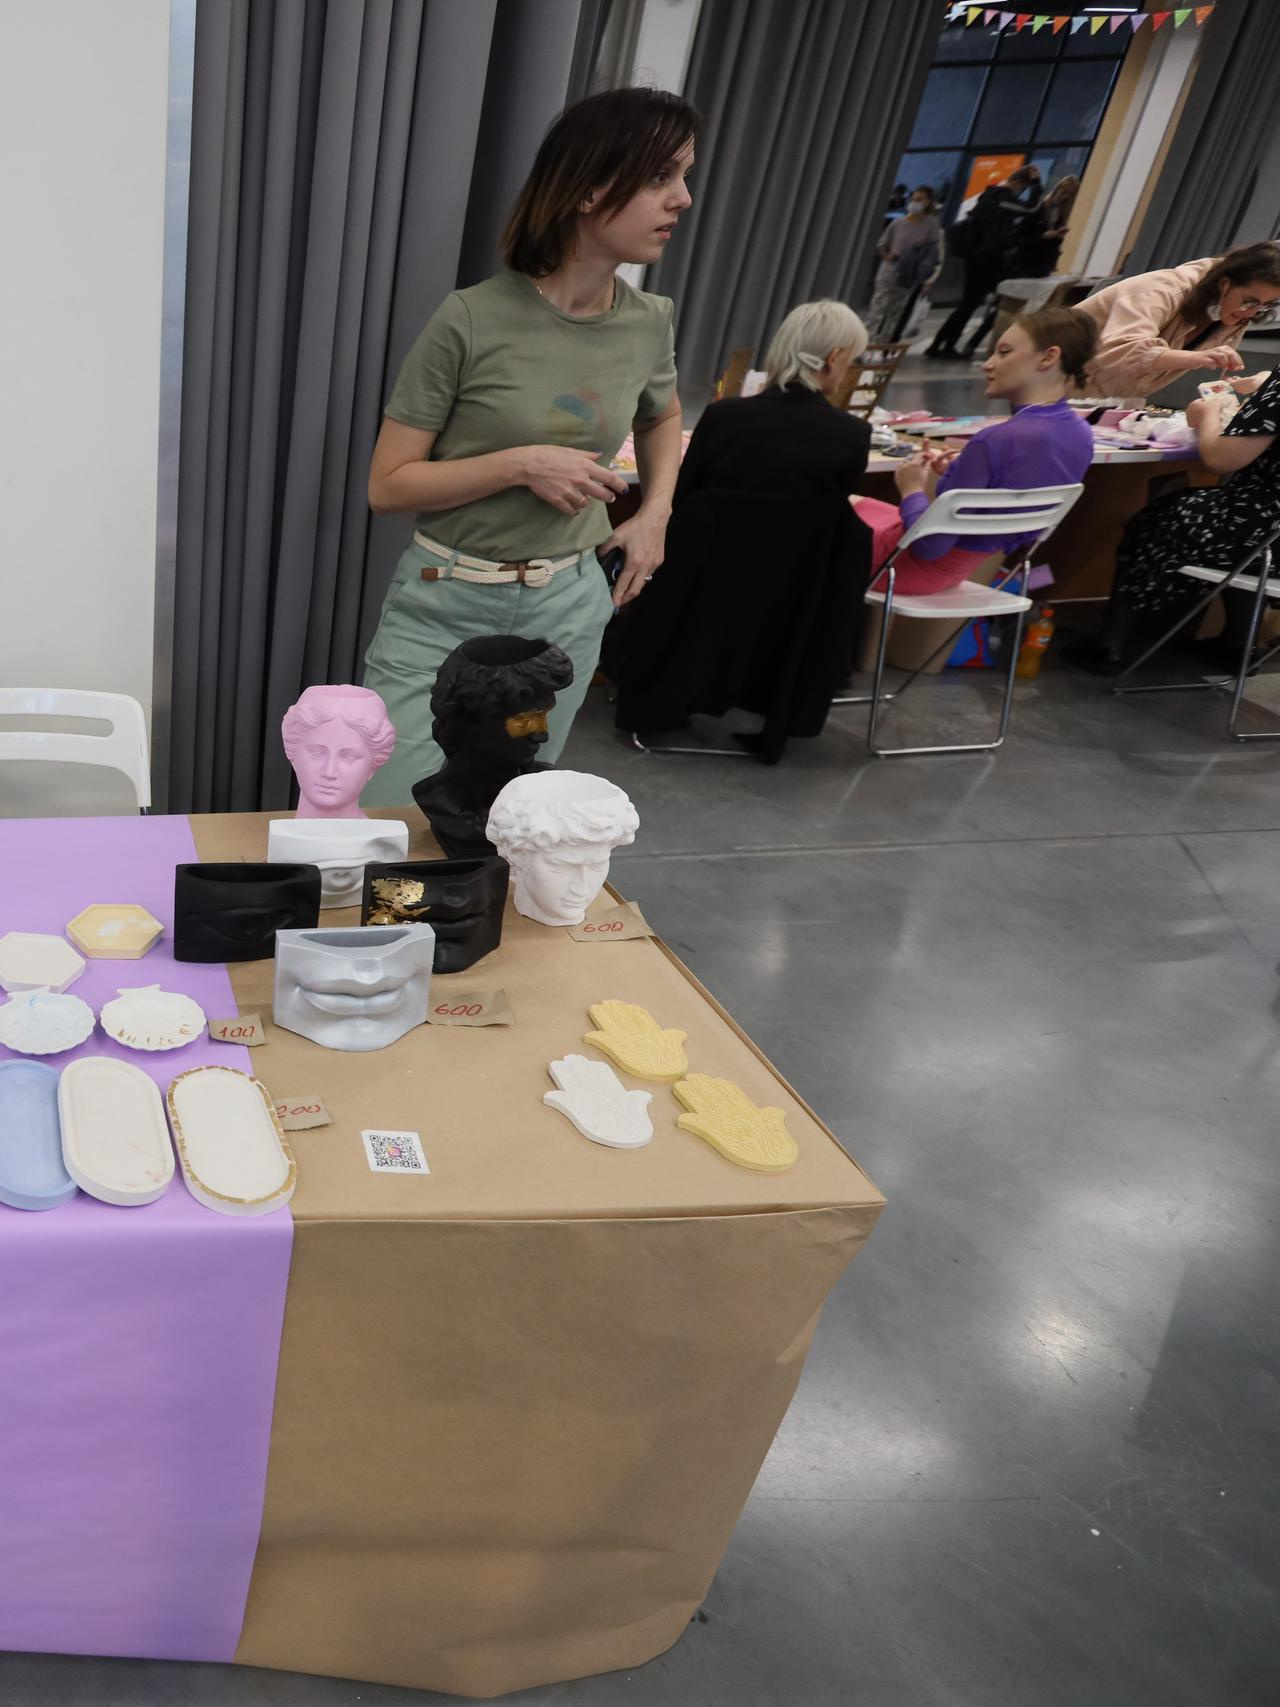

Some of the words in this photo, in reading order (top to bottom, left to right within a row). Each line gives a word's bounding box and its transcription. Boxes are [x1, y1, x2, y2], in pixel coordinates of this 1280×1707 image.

[583, 921, 624, 933] 600
[434, 1003, 482, 1016] 600
[219, 1025, 255, 1038] 100
[275, 1104, 321, 1119] 200
